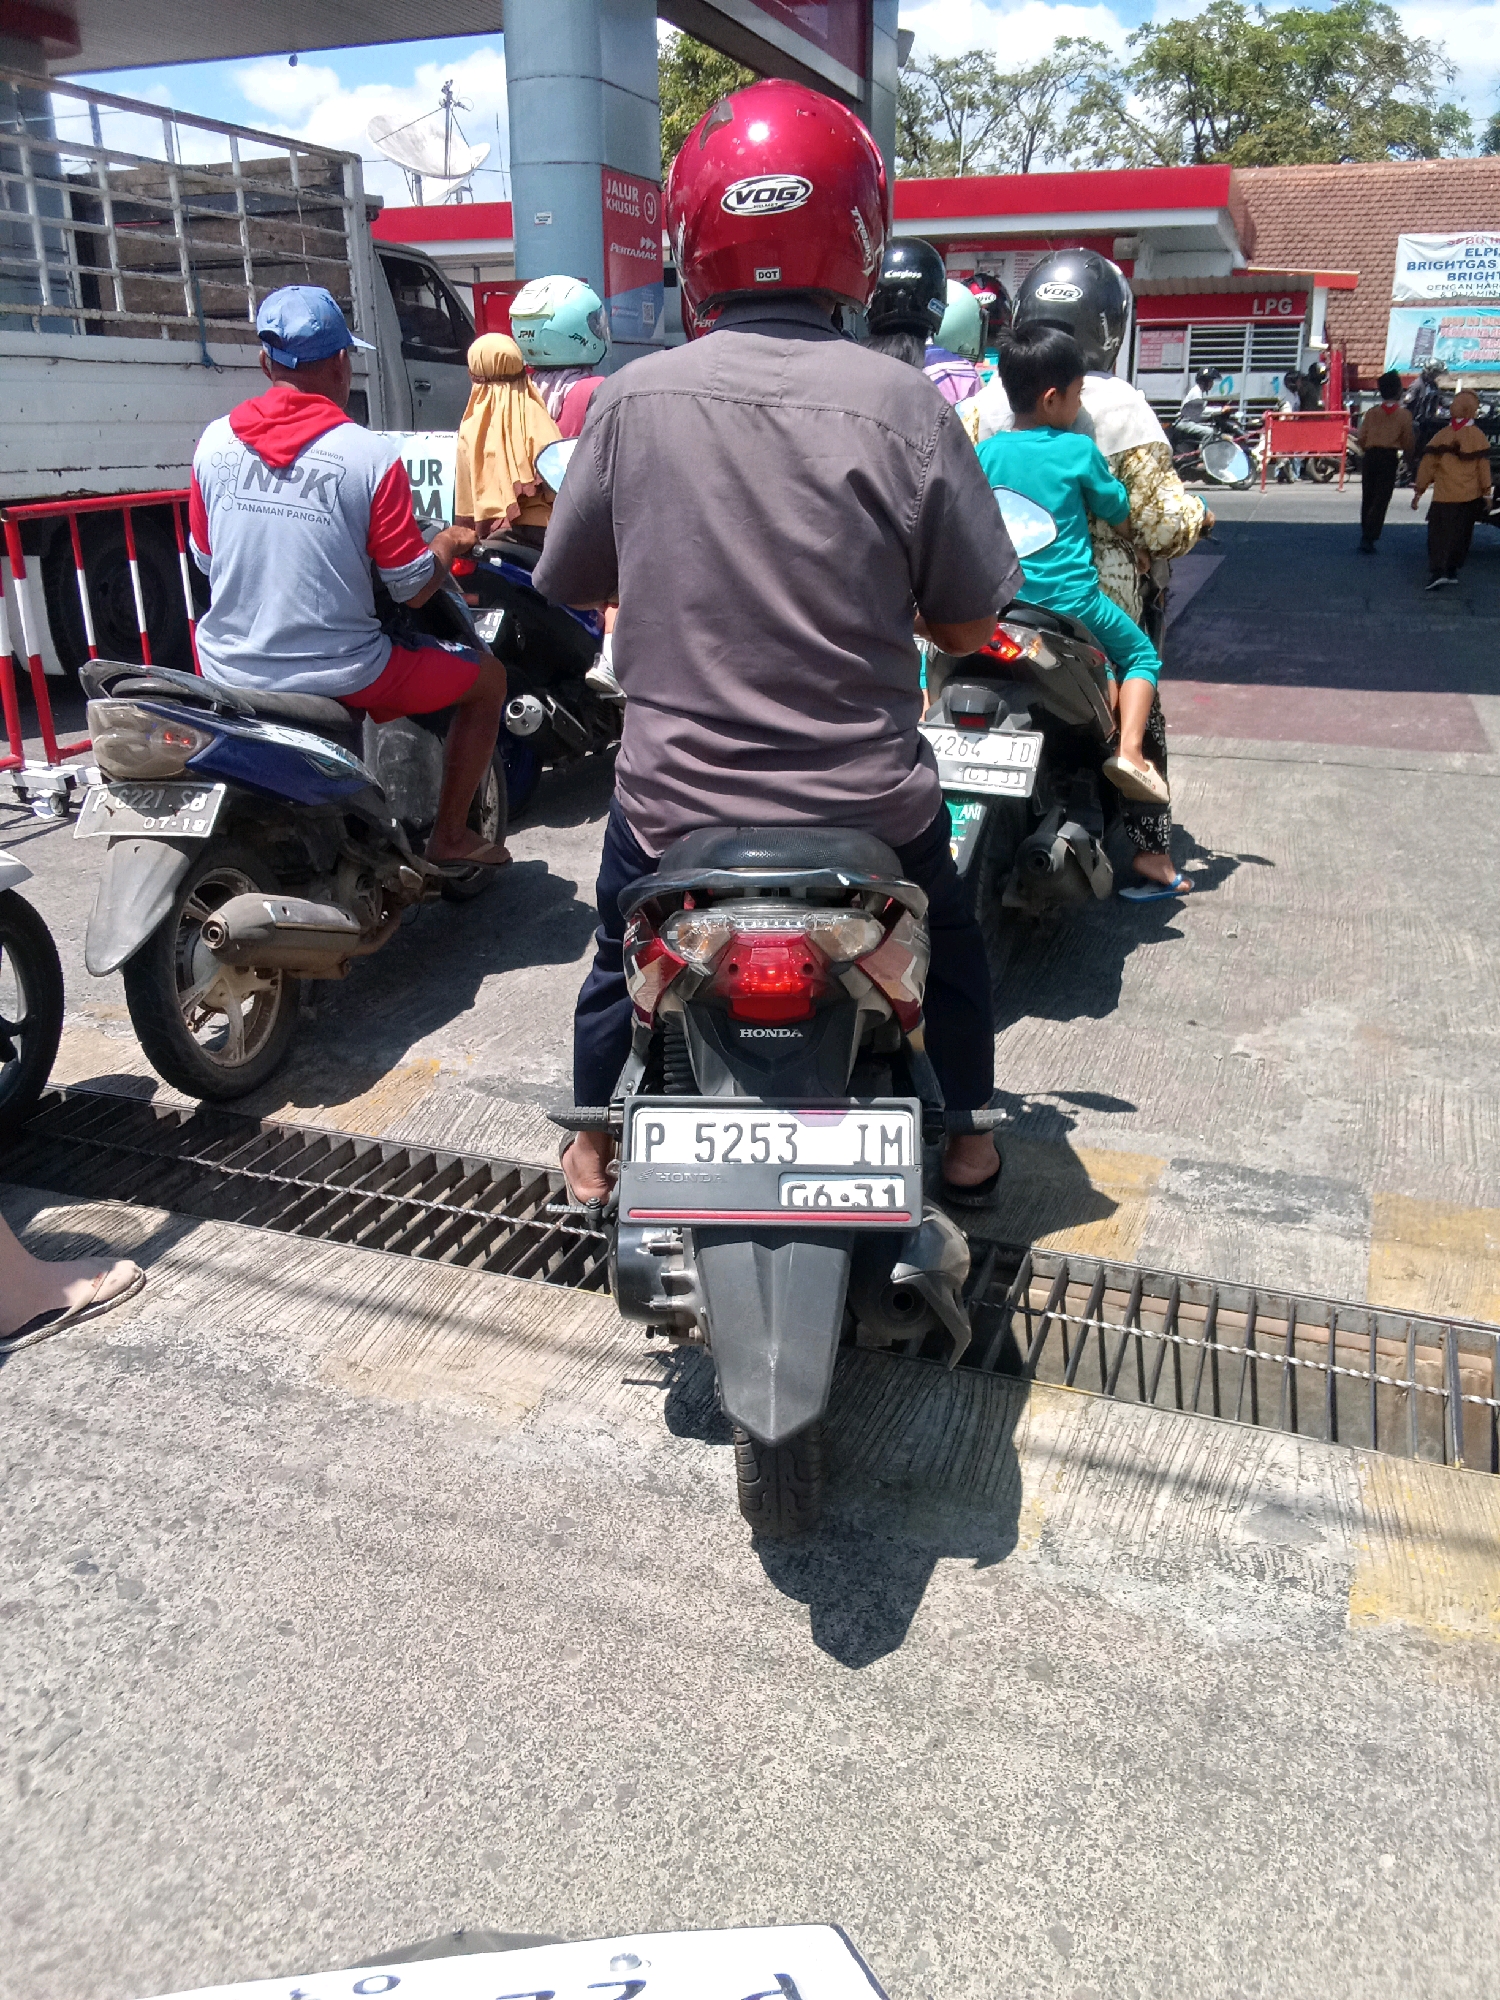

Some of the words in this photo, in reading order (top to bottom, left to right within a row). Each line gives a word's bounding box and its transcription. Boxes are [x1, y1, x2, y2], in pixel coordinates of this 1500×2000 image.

[605, 178, 639, 202] JALUR
[735, 186, 800, 205] VOG
[605, 196, 641, 217] KHUSUS
[609, 242, 657, 261] PERTAMAX
[1406, 259, 1498, 271] BRIGHTGAS
[758, 270, 778, 280] DOT
[1043, 287, 1077, 298] VOG
[1252, 297, 1293, 316] LPG
[518, 329, 536, 339] JPN
[568, 332, 589, 347] JPN
[242, 460, 339, 506] NPK
[236, 502, 285, 518] TANAMAN
[286, 509, 332, 527] PANGAN
[1006, 740, 1033, 764] ID
[91, 791, 108, 813] P
[114, 789, 167, 809] 6221
[739, 1028, 804, 1038] HONDA
[644, 1122, 666, 1163] P
[694, 1121, 798, 1164] 5253
[852, 1123, 904, 1166] IM
[655, 1171, 728, 1184] HONDA
